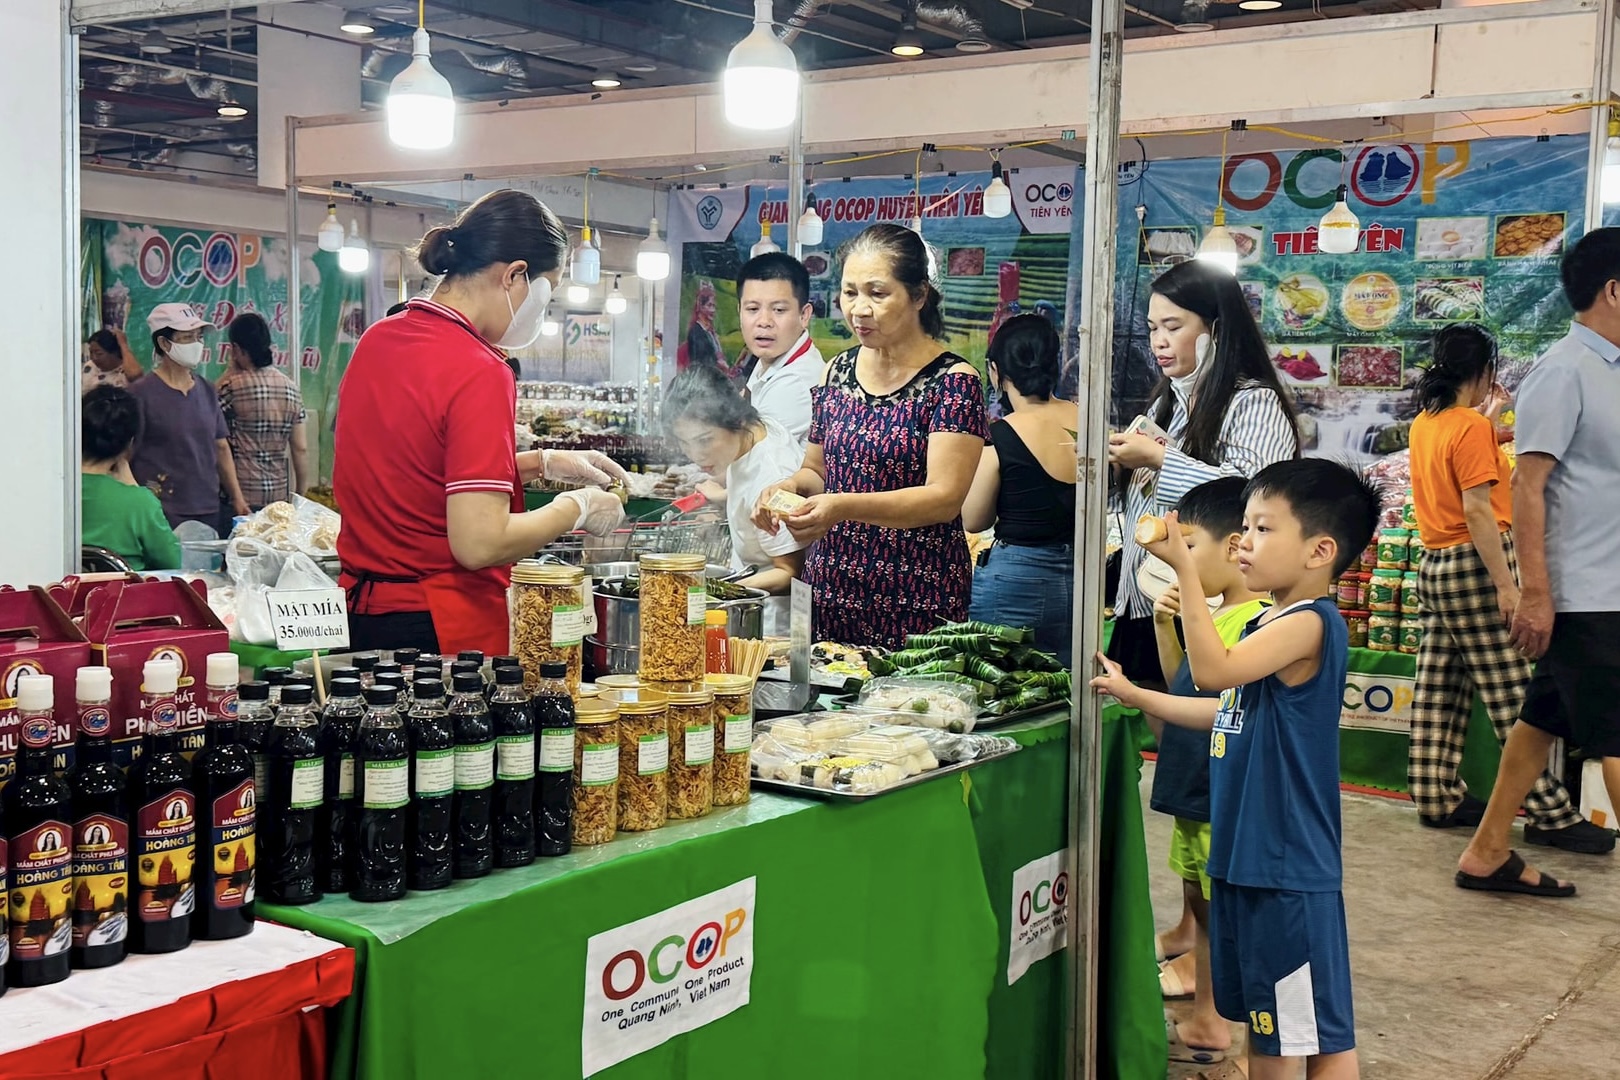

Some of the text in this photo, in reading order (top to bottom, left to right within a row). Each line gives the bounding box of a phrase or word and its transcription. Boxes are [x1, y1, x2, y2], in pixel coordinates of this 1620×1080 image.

[1219, 143, 1470, 211] OCOP
[834, 197, 875, 222] OCOP
[927, 186, 960, 218] TIÊN
[1030, 206, 1051, 218] TIÊN
[1273, 225, 1321, 255] TIÊ
[138, 232, 261, 289] OCOP
[276, 598, 342, 620] MẬT MÍA
[280, 625, 343, 638] 35.000đ/chai
[182, 732, 205, 749] TÂN
[1210, 731, 1226, 758] 19
[146, 836, 184, 851] HOÀNG
[17, 869, 58, 885] HOÀNG
[73, 859, 125, 873] OÀNG TÂN
[602, 908, 746, 1001] OCOP
[601, 1008, 624, 1022] One
[685, 976, 704, 990] One
[708, 956, 745, 977] Product
[618, 1010, 656, 1030] Quang
[690, 988, 707, 1004] Viet
[709, 977, 731, 995] Nam
[1249, 1010, 1275, 1036] 19
